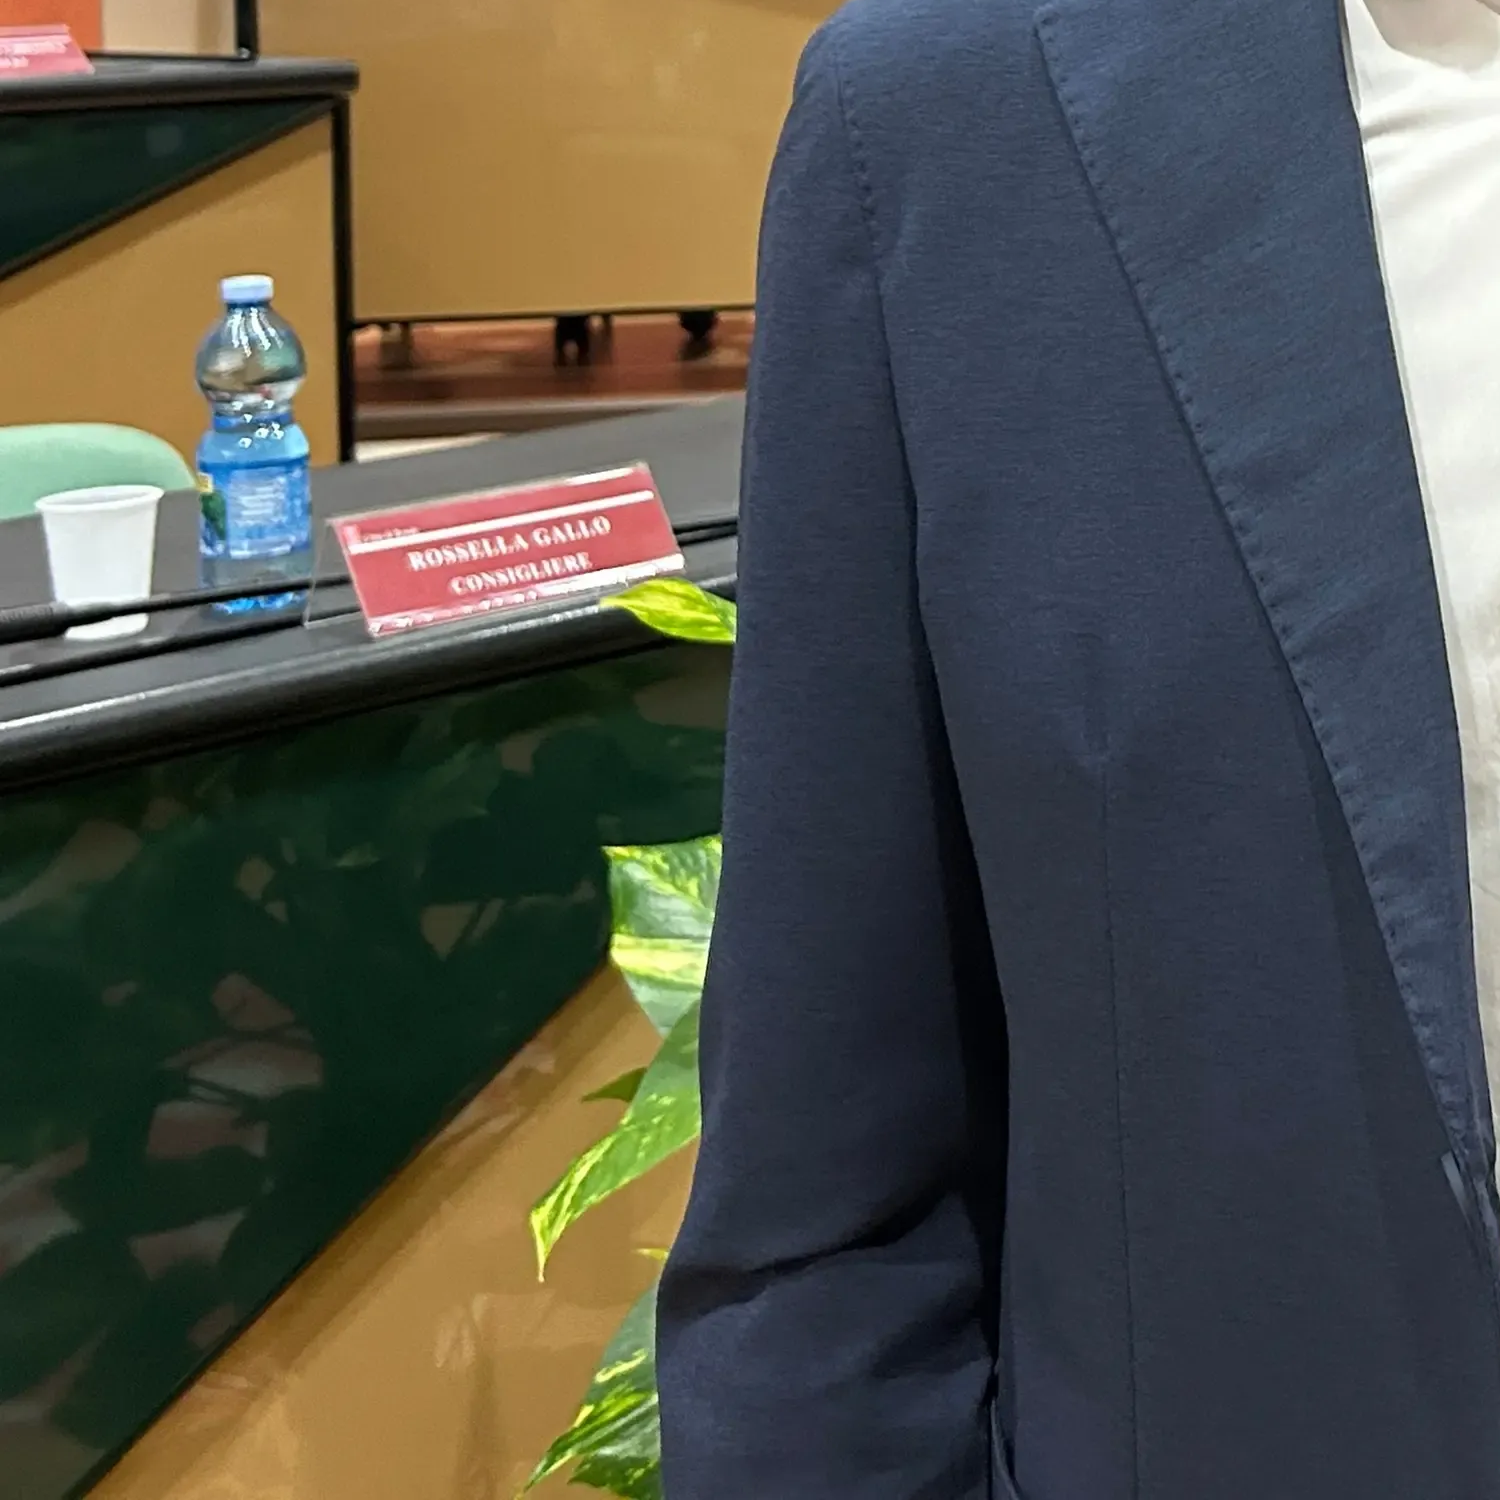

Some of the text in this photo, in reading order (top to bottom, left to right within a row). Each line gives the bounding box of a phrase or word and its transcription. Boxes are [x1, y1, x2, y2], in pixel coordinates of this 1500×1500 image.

[406, 533, 529, 572] ROSSELLA
[531, 514, 612, 548] GALLO
[449, 551, 593, 596] CONSIGLIERE
